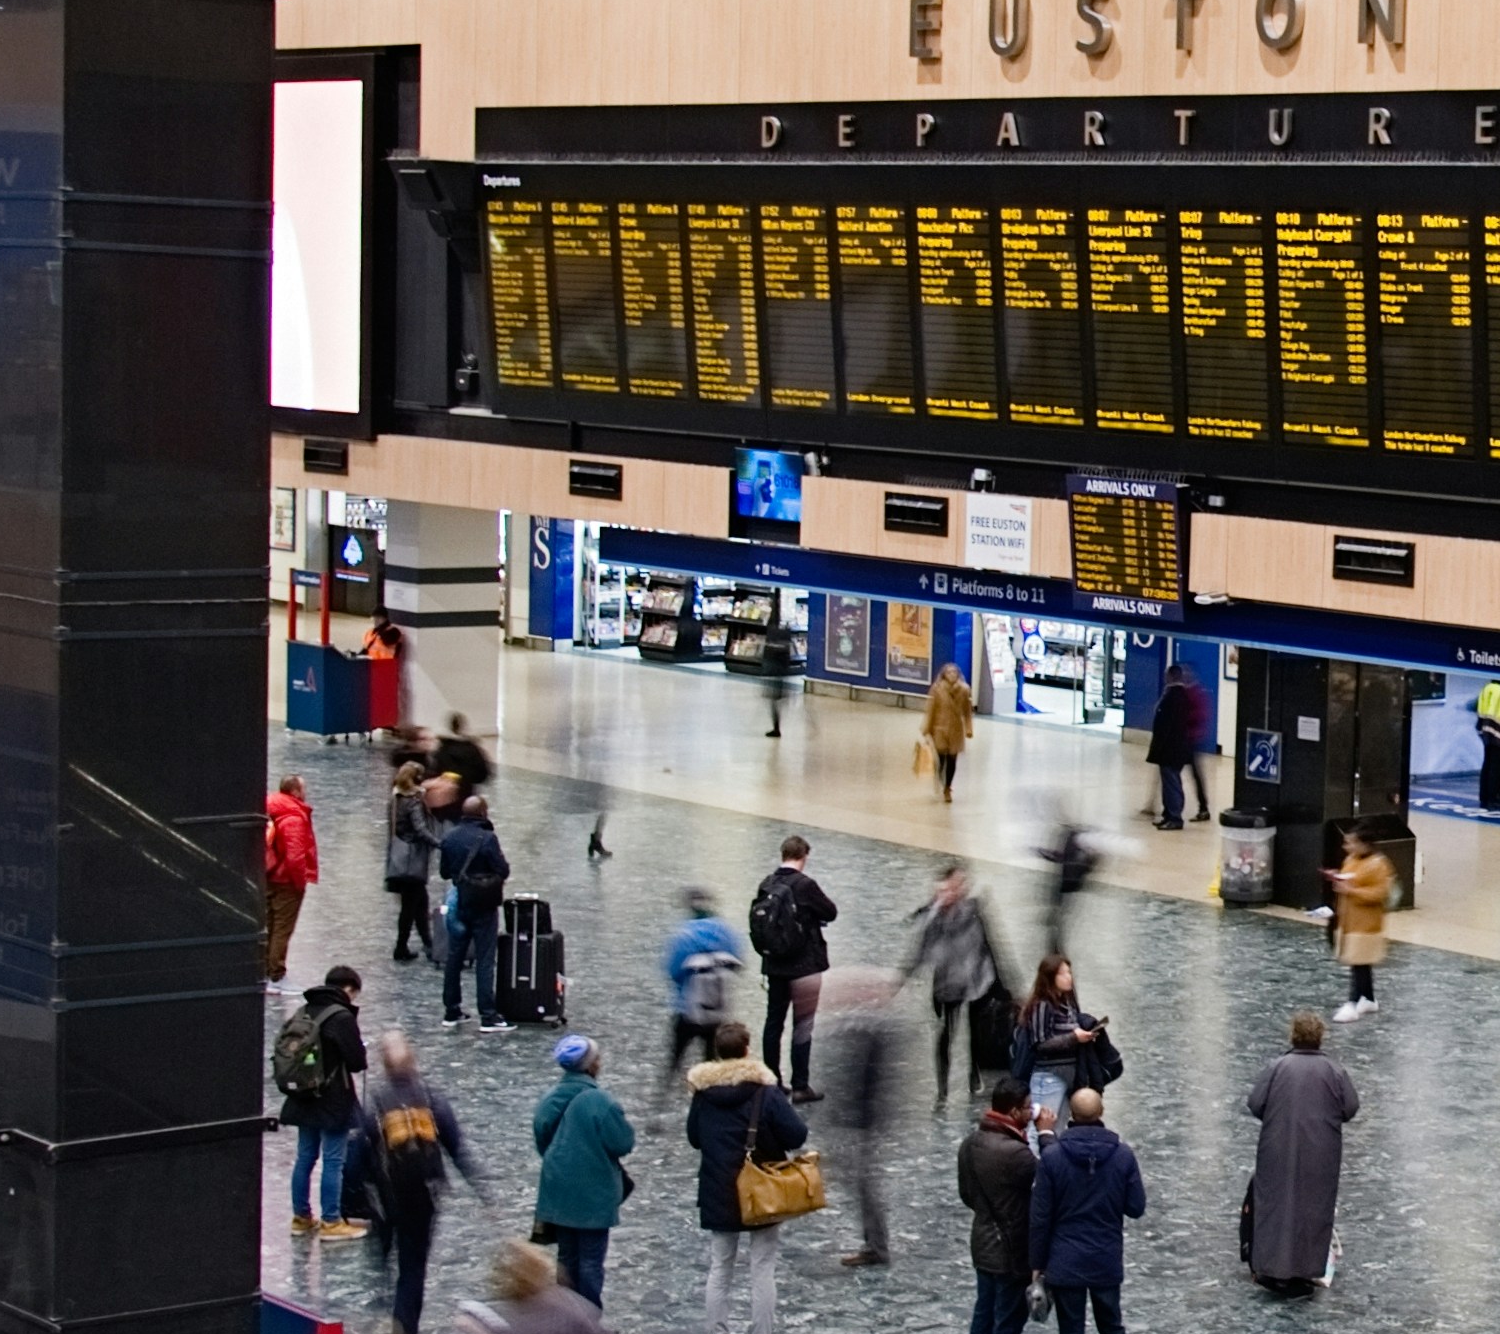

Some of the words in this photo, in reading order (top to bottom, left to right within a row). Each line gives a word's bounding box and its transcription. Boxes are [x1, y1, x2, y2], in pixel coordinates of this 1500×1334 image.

[1086, 479, 1129, 495] ARRIVALS
[1131, 483, 1156, 497] ONLY
[971, 516, 990, 528] FREE
[992, 518, 1025, 532] EUSTON
[971, 534, 1005, 548] STATION
[1007, 537, 1025, 549] WiFi
[953, 577, 1003, 599] Platforms
[1006, 584, 1014, 600] 8
[1016, 587, 1028, 602] to
[1031, 588, 1045, 603] 11
[1093, 597, 1136, 613] ARRIVALS
[1137, 601, 1162, 615] ONLY
